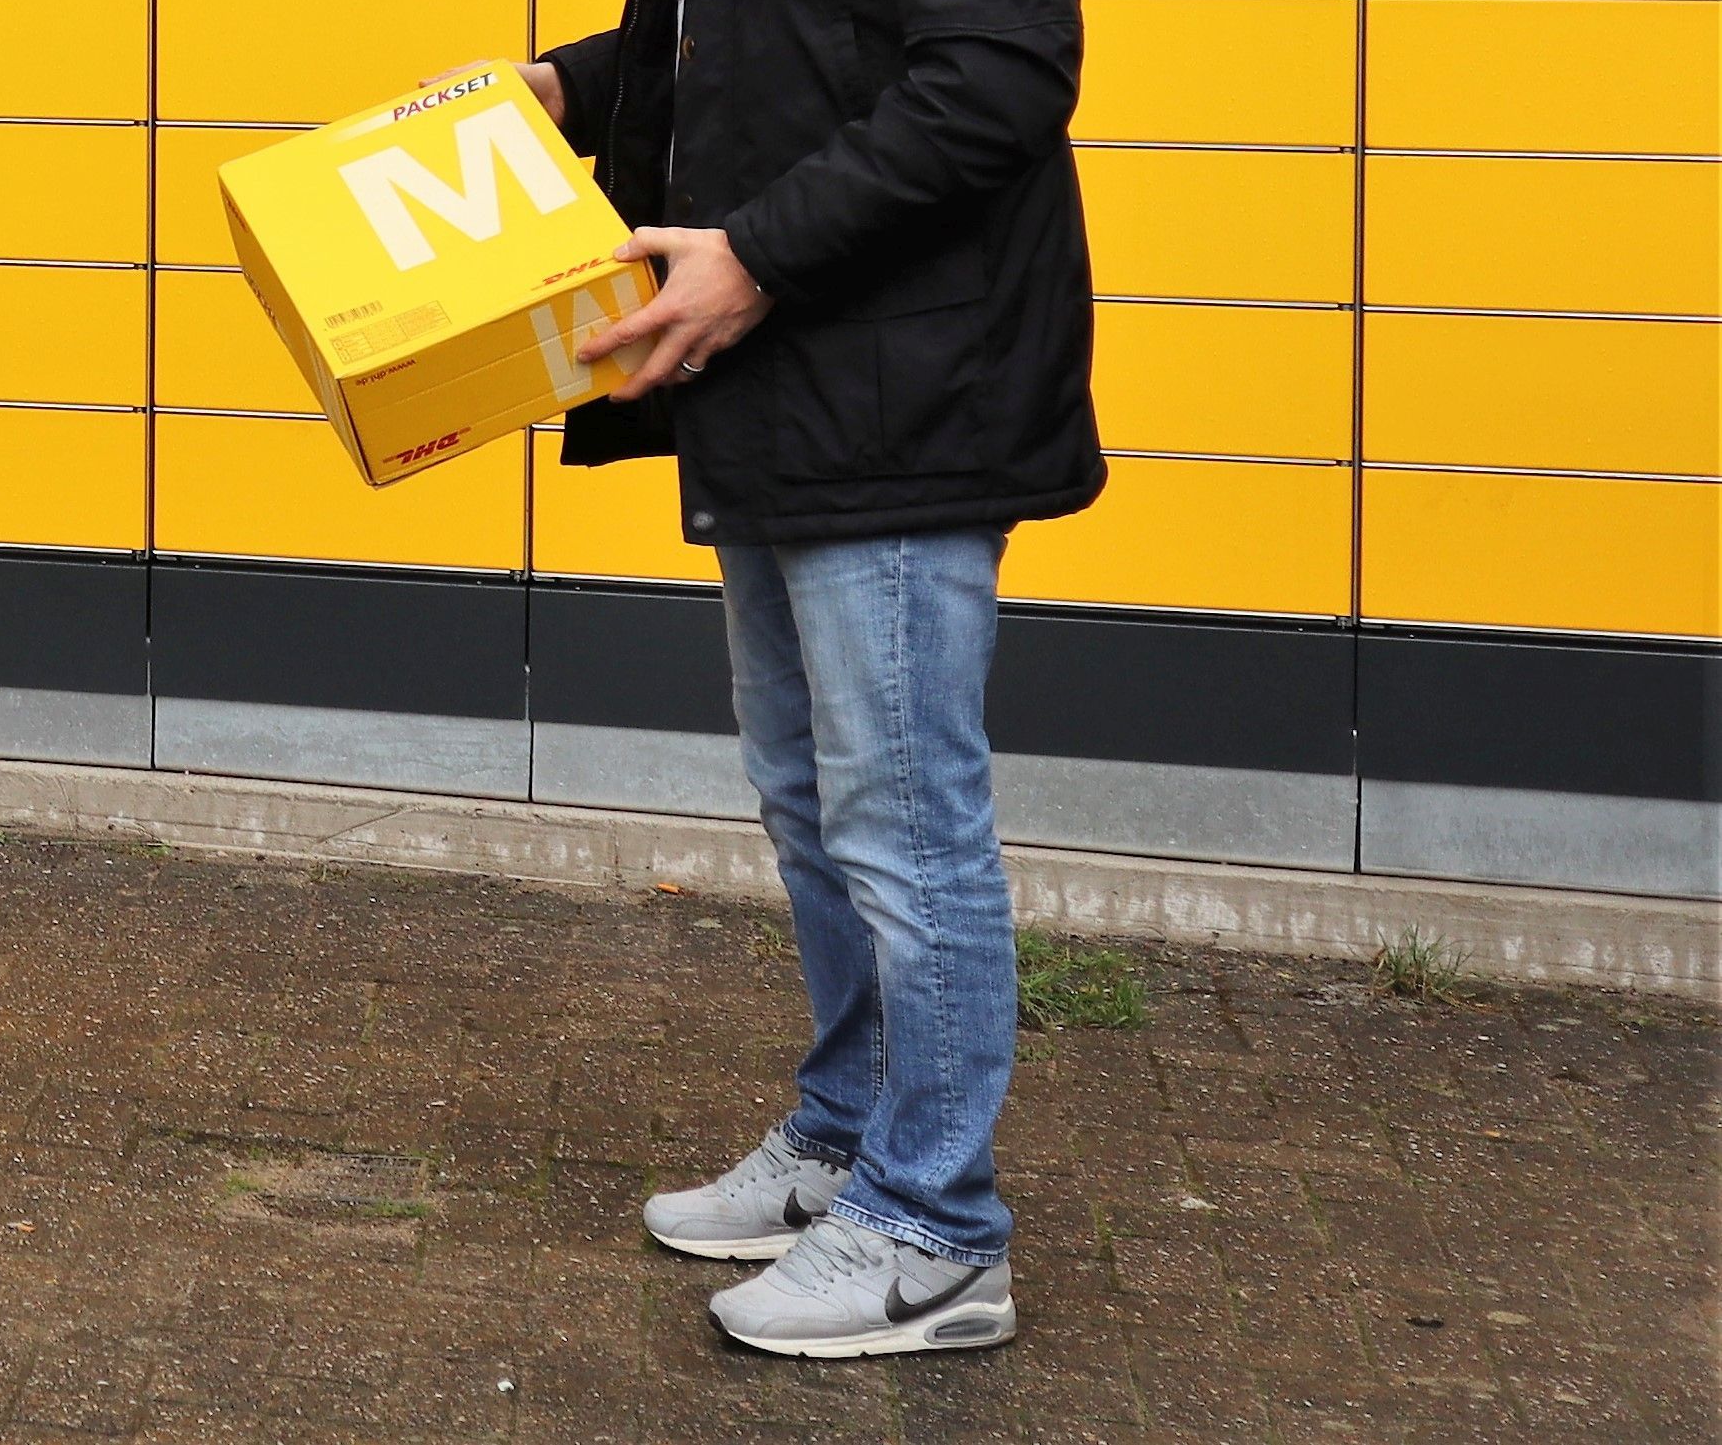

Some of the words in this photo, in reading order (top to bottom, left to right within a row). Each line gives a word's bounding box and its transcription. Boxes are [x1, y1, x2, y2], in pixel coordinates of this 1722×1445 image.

[392, 71, 495, 124] PACKSET
[339, 100, 578, 272] M
[542, 257, 605, 286] DHL
[395, 431, 461, 465] DHL
